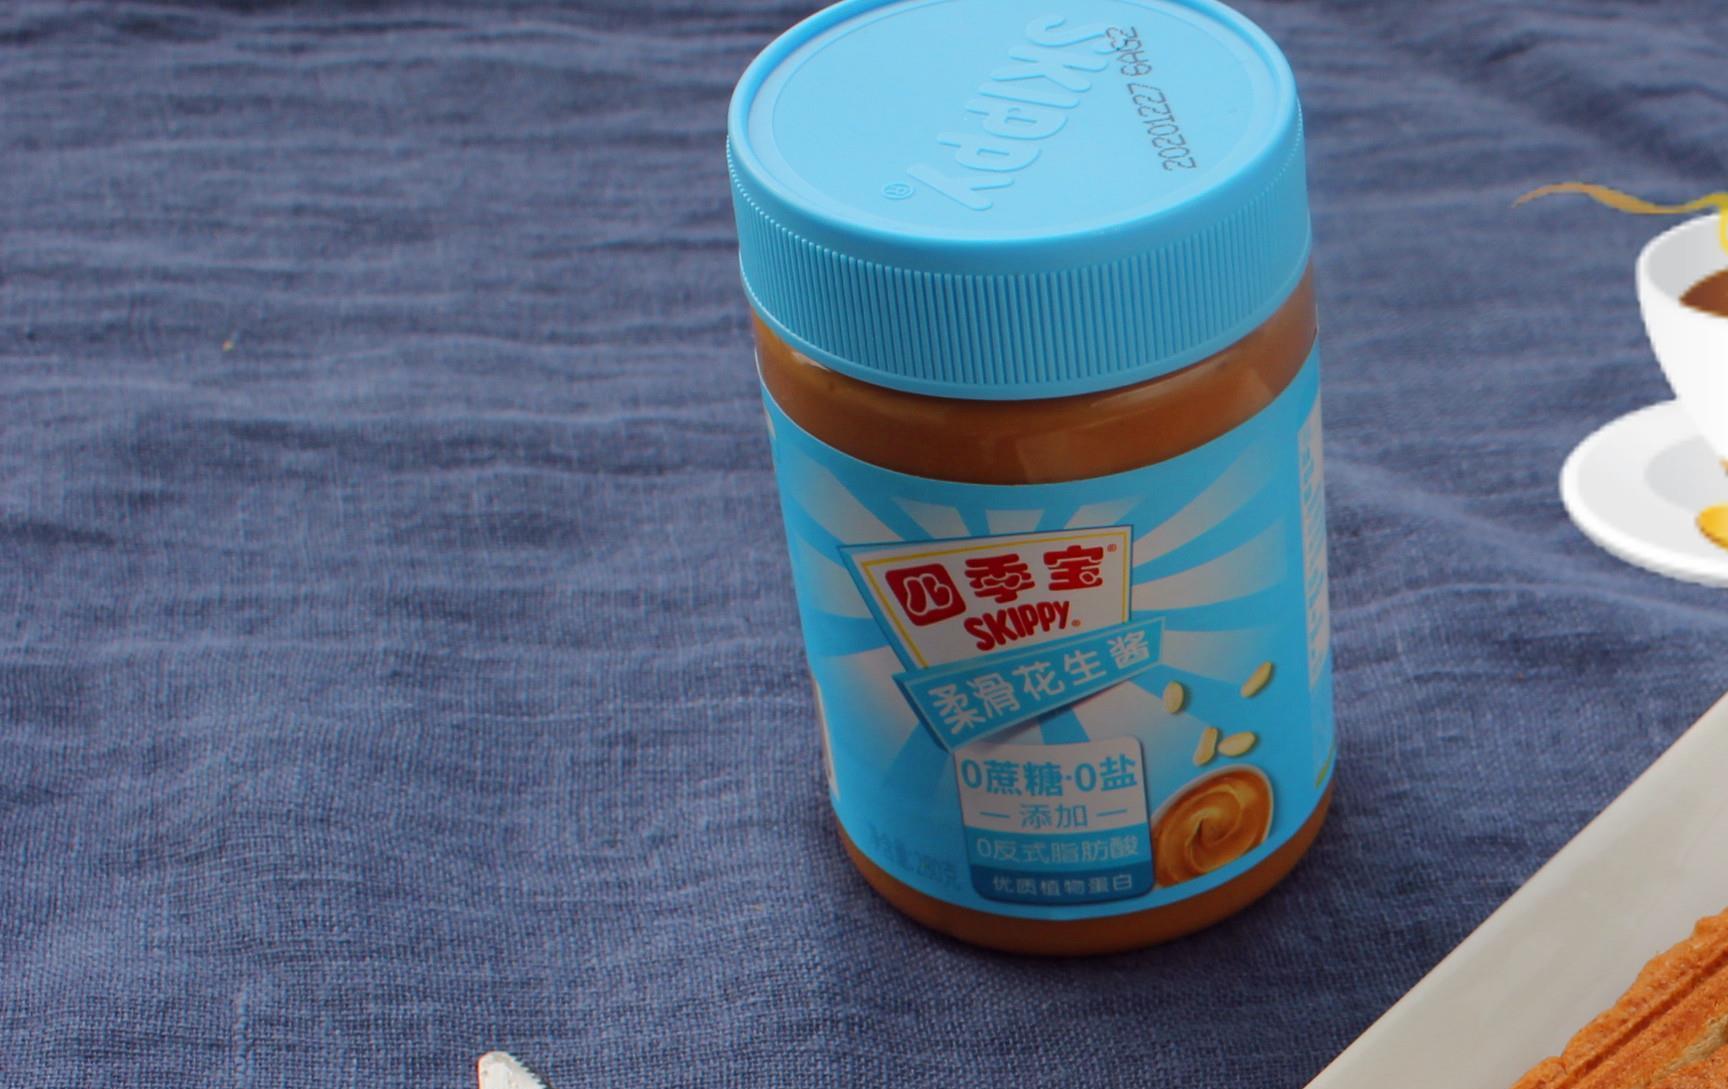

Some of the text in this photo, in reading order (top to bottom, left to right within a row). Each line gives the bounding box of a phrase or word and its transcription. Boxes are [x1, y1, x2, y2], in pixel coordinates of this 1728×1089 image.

[906, 14, 1110, 211] SKIPPY
[1126, 82, 1197, 171] 20201227
[885, 545, 1104, 626] 四季宝
[963, 600, 1070, 651] SKIPPY
[928, 630, 1149, 735] 柔滑花生酱
[976, 835, 1139, 864] 0反式脂肪酸
[1019, 803, 1088, 829] 添加
